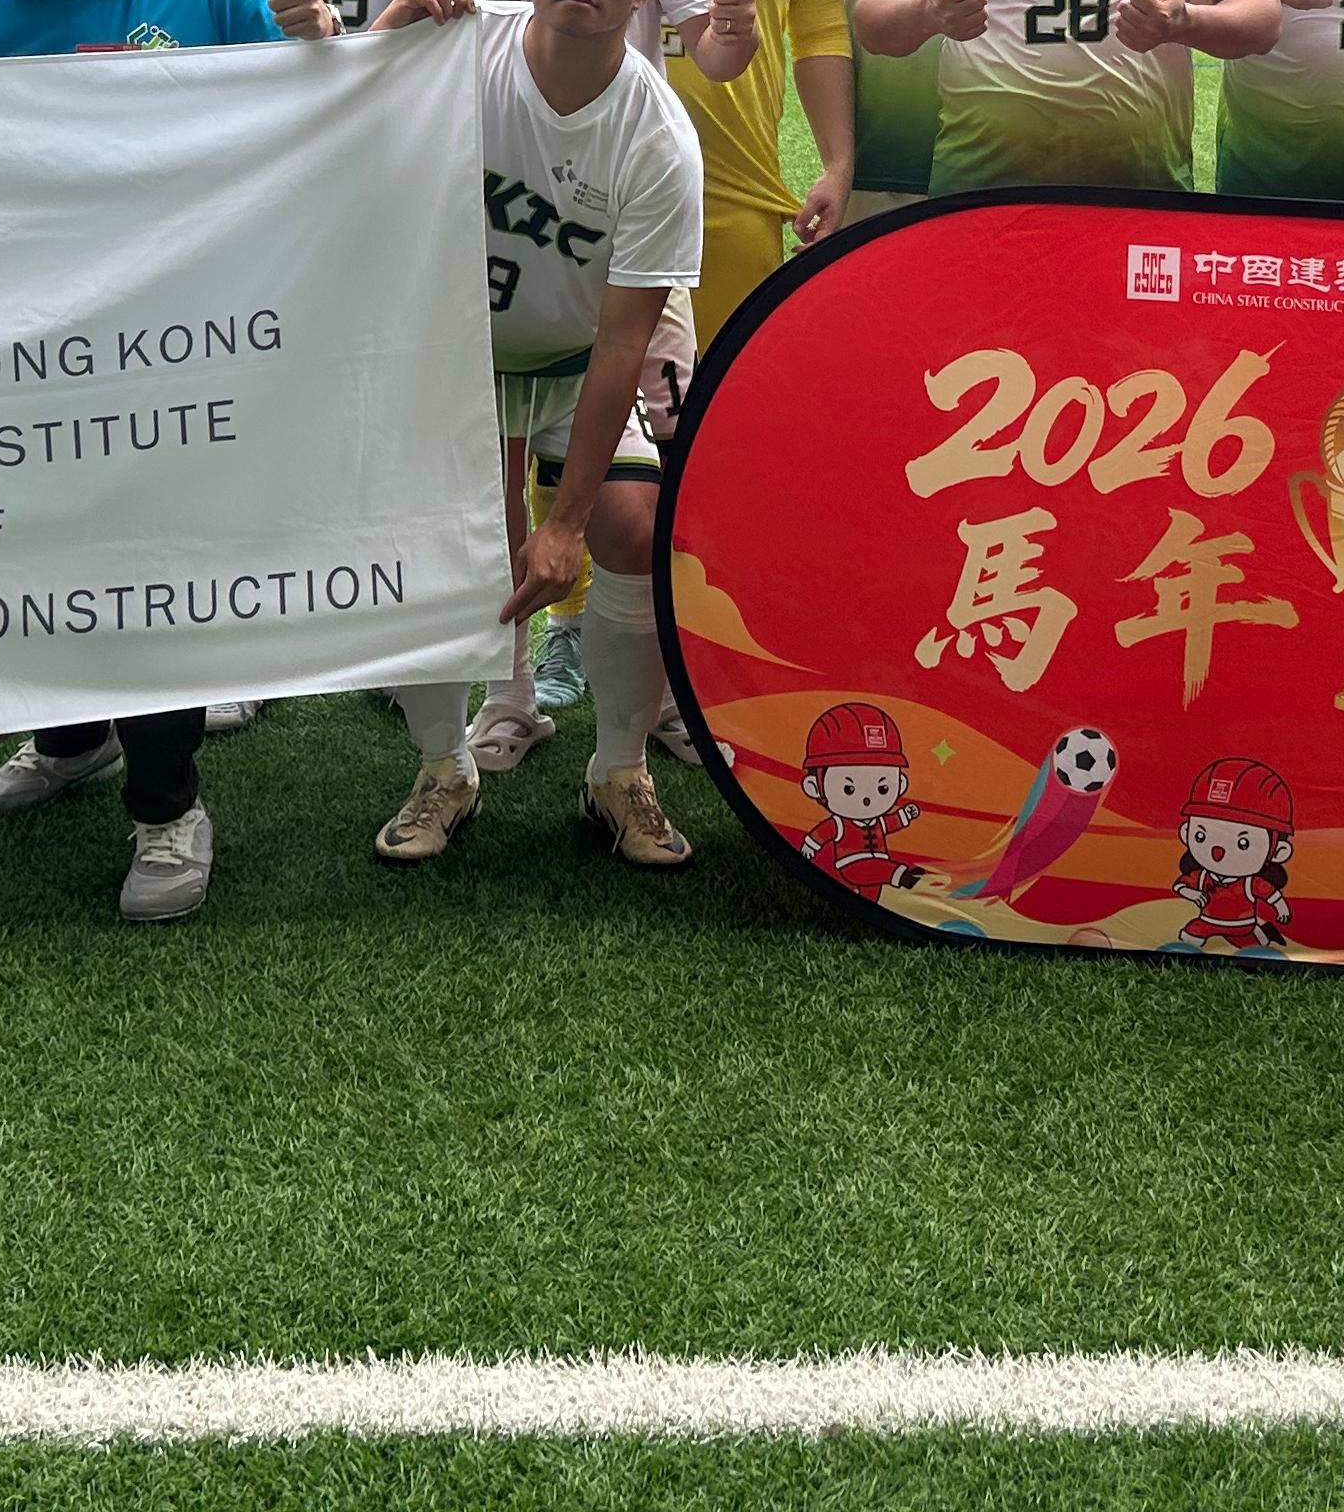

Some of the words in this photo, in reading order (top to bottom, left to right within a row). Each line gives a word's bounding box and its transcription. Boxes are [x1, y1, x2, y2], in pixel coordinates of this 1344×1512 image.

[484, 168, 608, 268] KIC
[117, 308, 284, 372] KONG
[1192, 291, 1234, 307] CHINA
[1237, 294, 1271, 309] STATE
[904, 340, 1288, 499] 2026
[914, 506, 1300, 711] 馬年
